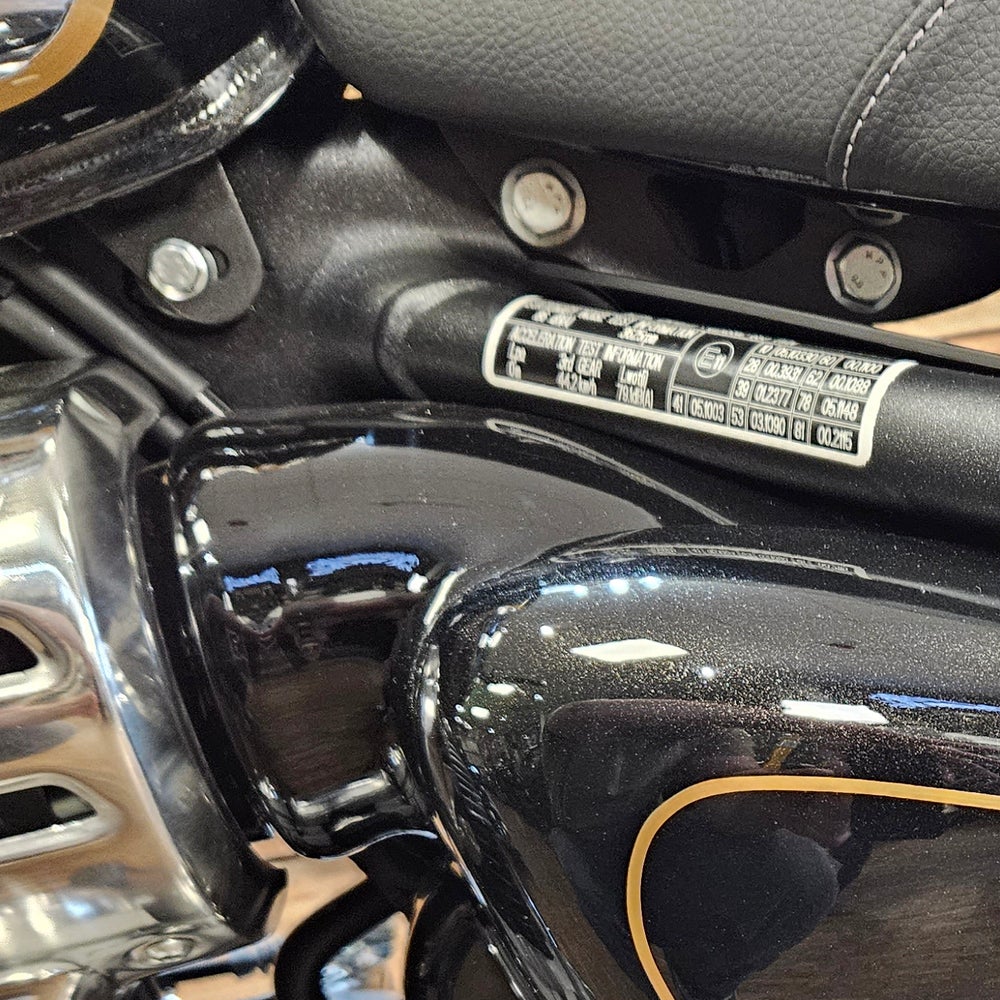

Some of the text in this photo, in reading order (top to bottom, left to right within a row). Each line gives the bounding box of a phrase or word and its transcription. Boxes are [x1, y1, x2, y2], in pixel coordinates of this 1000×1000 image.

[577, 338, 605, 359] TEST
[603, 344, 666, 372] INFORMATION
[576, 356, 603, 379] GEAR
[805, 369, 824, 386] 62
[735, 379, 751, 399] 39
[672, 393, 684, 414] 41
[797, 391, 813, 412] 78
[731, 405, 745, 427] 53
[750, 410, 786, 436] 03.1090
[793, 420, 806, 441] 81
